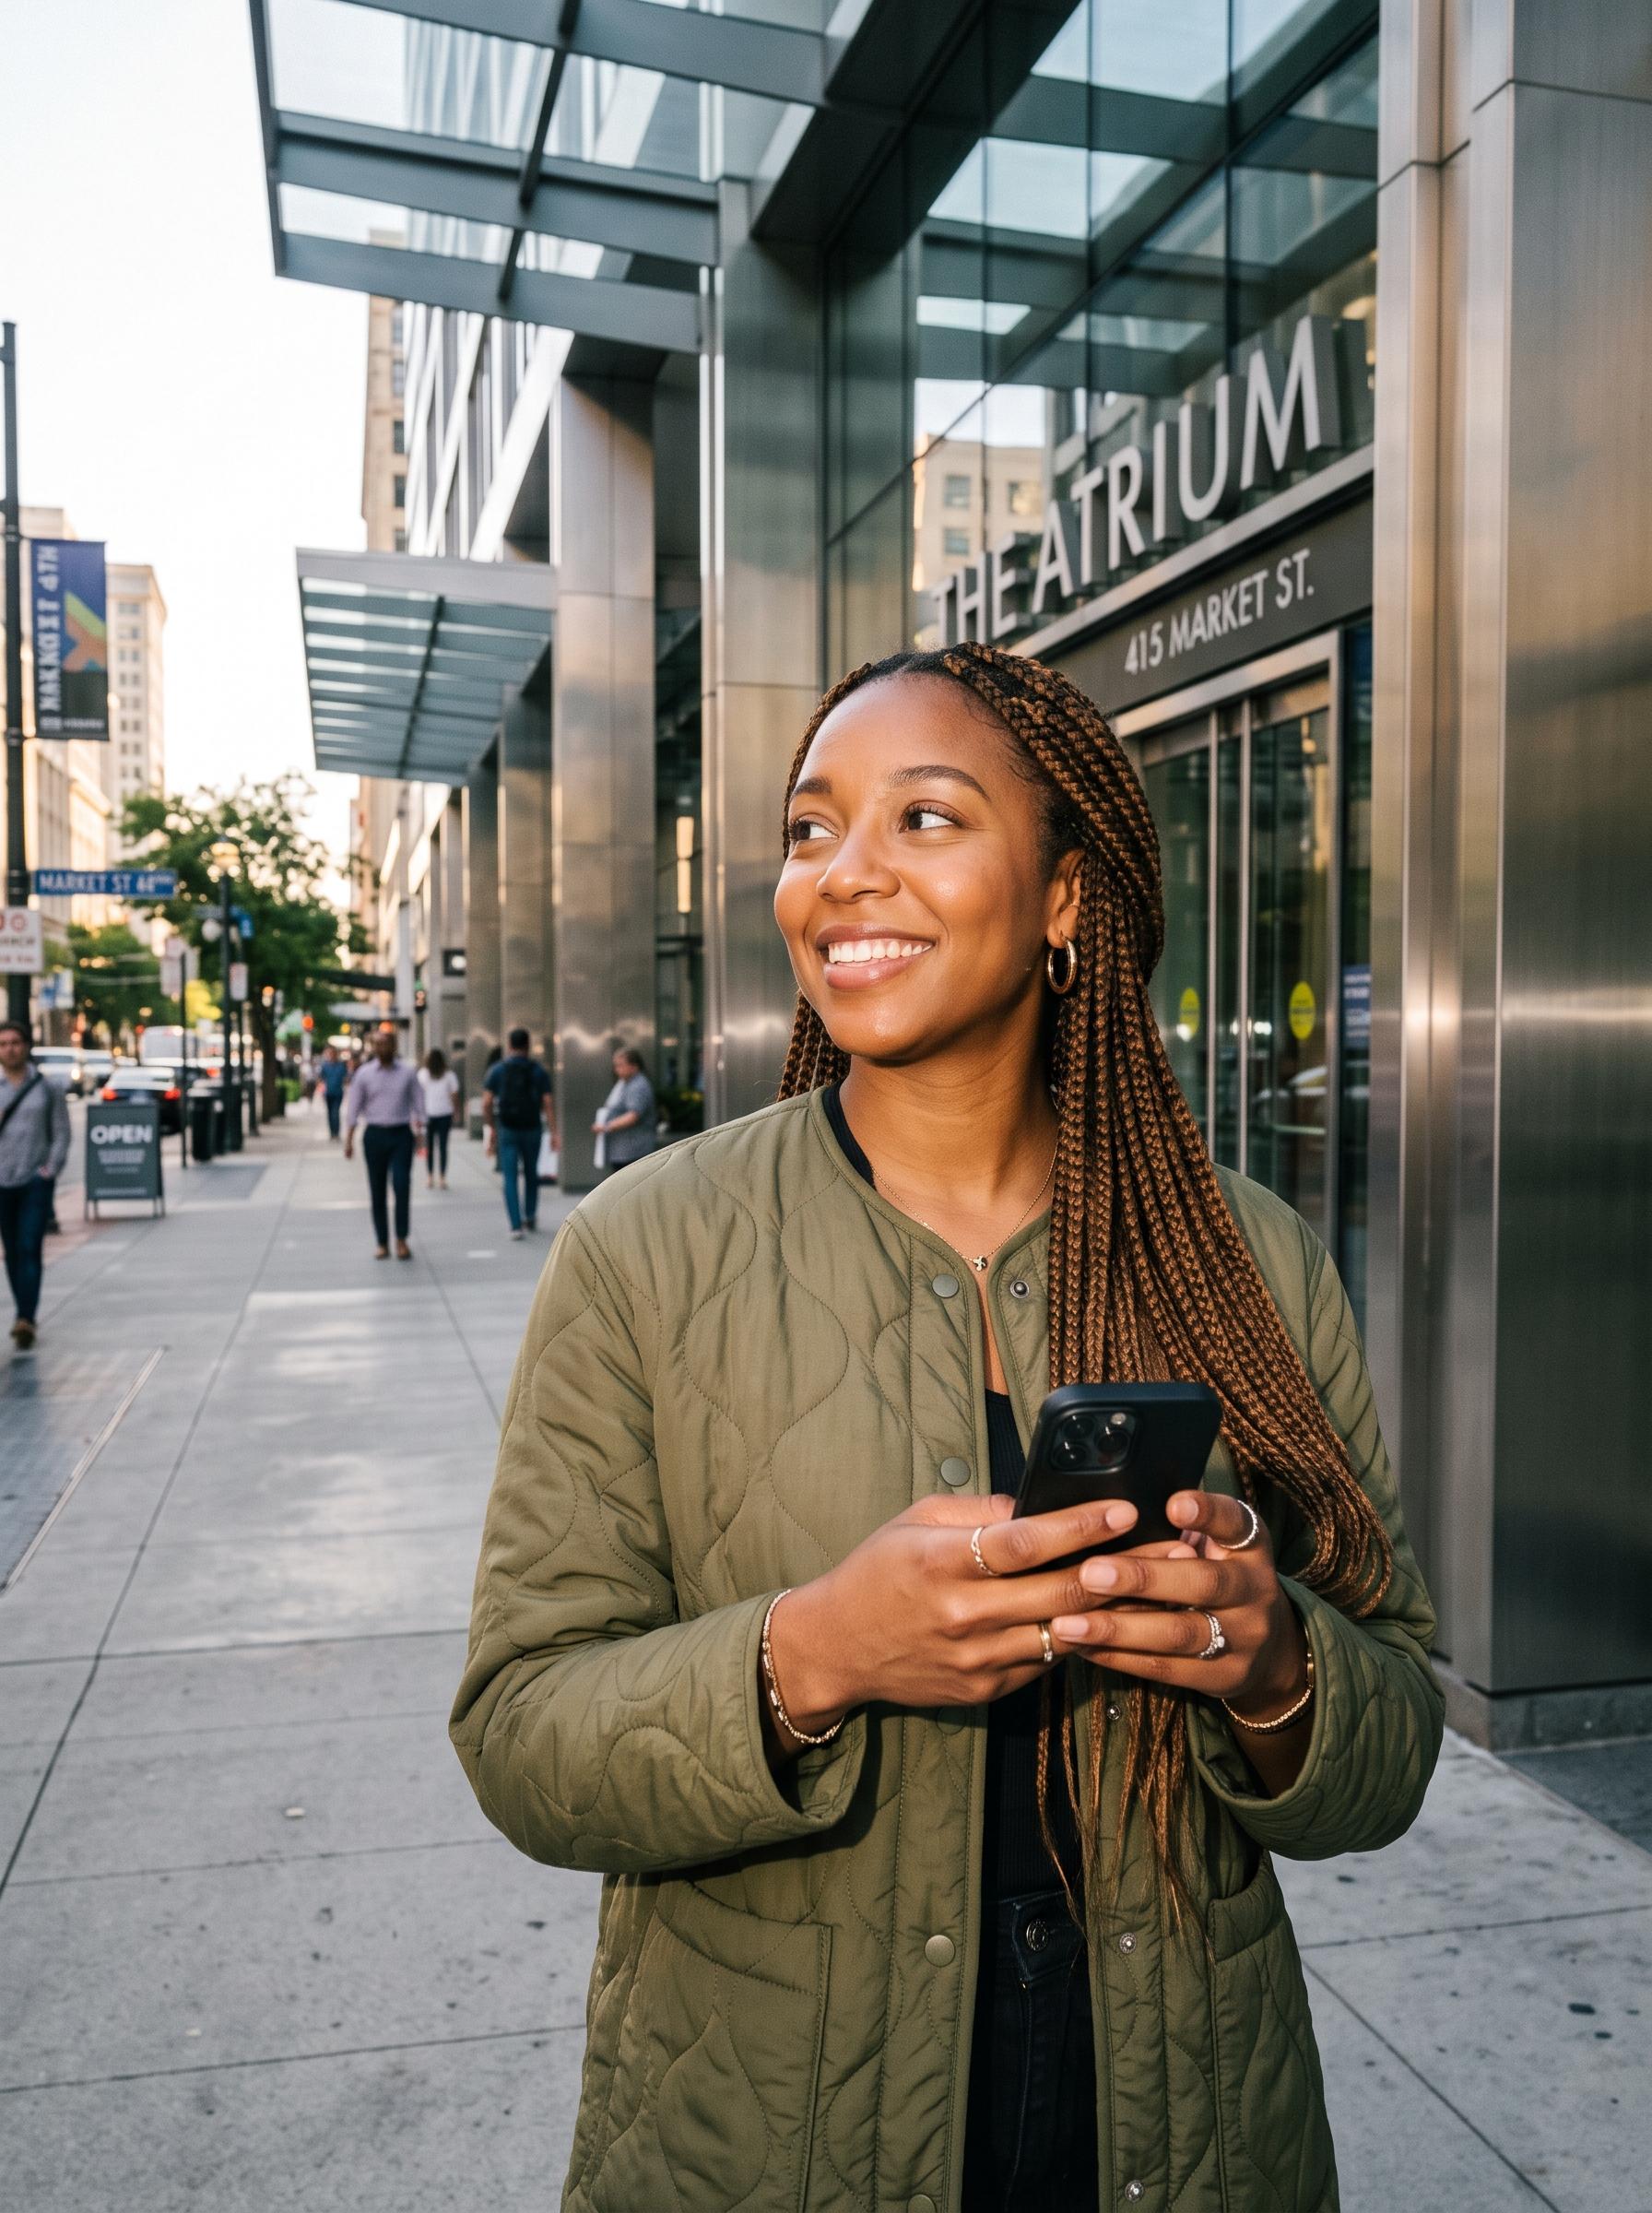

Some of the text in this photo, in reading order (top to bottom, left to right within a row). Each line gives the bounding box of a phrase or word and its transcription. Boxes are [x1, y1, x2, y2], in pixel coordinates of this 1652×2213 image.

[933, 316, 1320, 646] THE ATRIUM
[1124, 549, 1315, 676] 415 MARKET ST.
[39, 873, 107, 893] MARKET
[112, 874, 131, 893] ST
[89, 1124, 152, 1144] OPEN
